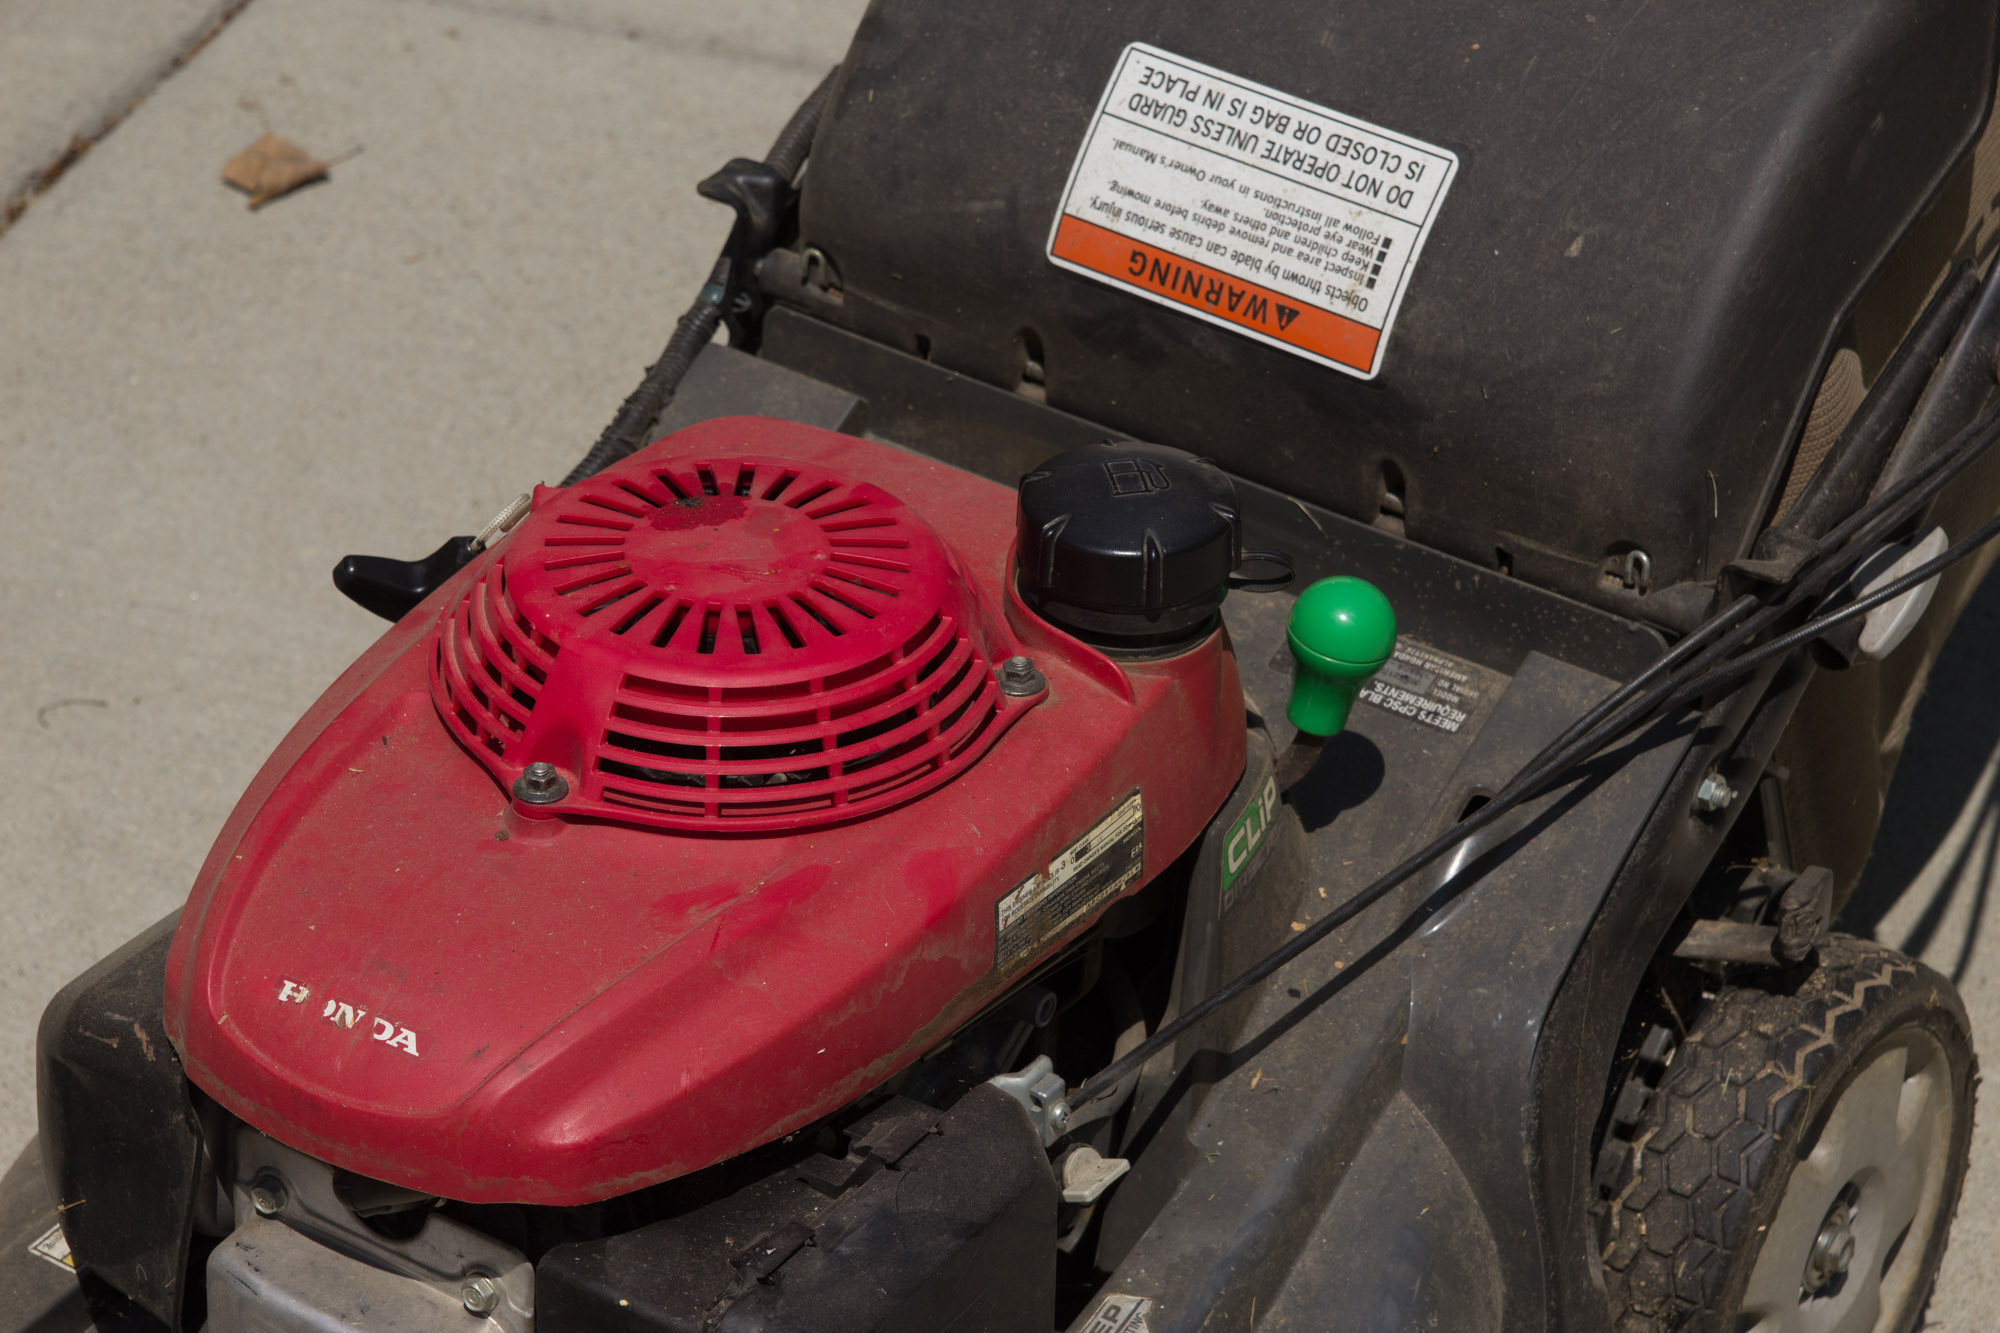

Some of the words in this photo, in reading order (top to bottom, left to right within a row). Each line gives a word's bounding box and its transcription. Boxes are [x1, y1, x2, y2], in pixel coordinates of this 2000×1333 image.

[1138, 66, 1200, 102] PLACE
[1128, 93, 1187, 127] GUARD
[1202, 88, 1224, 110] IN
[1226, 98, 1247, 118] IS
[1249, 105, 1290, 134] BAG
[1190, 114, 1258, 153] UNLESS
[1292, 120, 1321, 144] OR
[1111, 138, 1157, 164] Manual.
[1260, 139, 1340, 182] OPERATE
[1325, 133, 1401, 173] CLOSED
[1159, 155, 1205, 181] Owner's
[1404, 160, 1425, 182] IS
[1107, 179, 1150, 204] mowing.
[1208, 174, 1236, 189] your
[1238, 184, 1250, 195] in
[1341, 170, 1383, 198] NOT
[1088, 194, 1123, 218] injury.
[1199, 198, 1230, 217] away.
[1253, 189, 1322, 222] instructions
[1385, 185, 1414, 209] DO
[1154, 199, 1188, 220] before
[1124, 210, 1166, 234] serious
[1191, 212, 1225, 232] debris
[1232, 212, 1267, 231] others
[1262, 208, 1321, 236] protection.
[1268, 225, 1290, 240] and
[1323, 216, 1340, 227] all
[1168, 227, 1203, 247] cause
[1228, 226, 1269, 247] remove
[1323, 230, 1343, 244] eye
[1342, 222, 1380, 245] Follow
[1205, 240, 1227, 256] can
[1271, 242, 1293, 256] and
[1293, 234, 1338, 257] children
[1345, 239, 1373, 258] Wear
[1230, 249, 1262, 272] blade
[1296, 250, 1321, 266] area
[1341, 250, 1369, 271] Keep
[1264, 260, 1280, 279] by
[1323, 260, 1364, 285] Inspect
[1128, 249, 1267, 323] WARNING
[1281, 268, 1321, 294] thrown
[1324, 284, 1368, 312] Objects
[1393, 651, 1424, 666] HONDA
[1359, 688, 1383, 705] BLA
[1374, 681, 1466, 722] REQUIREMENTS.
[1383, 698, 1416, 716] CPSC
[1418, 710, 1460, 732] MEETS
